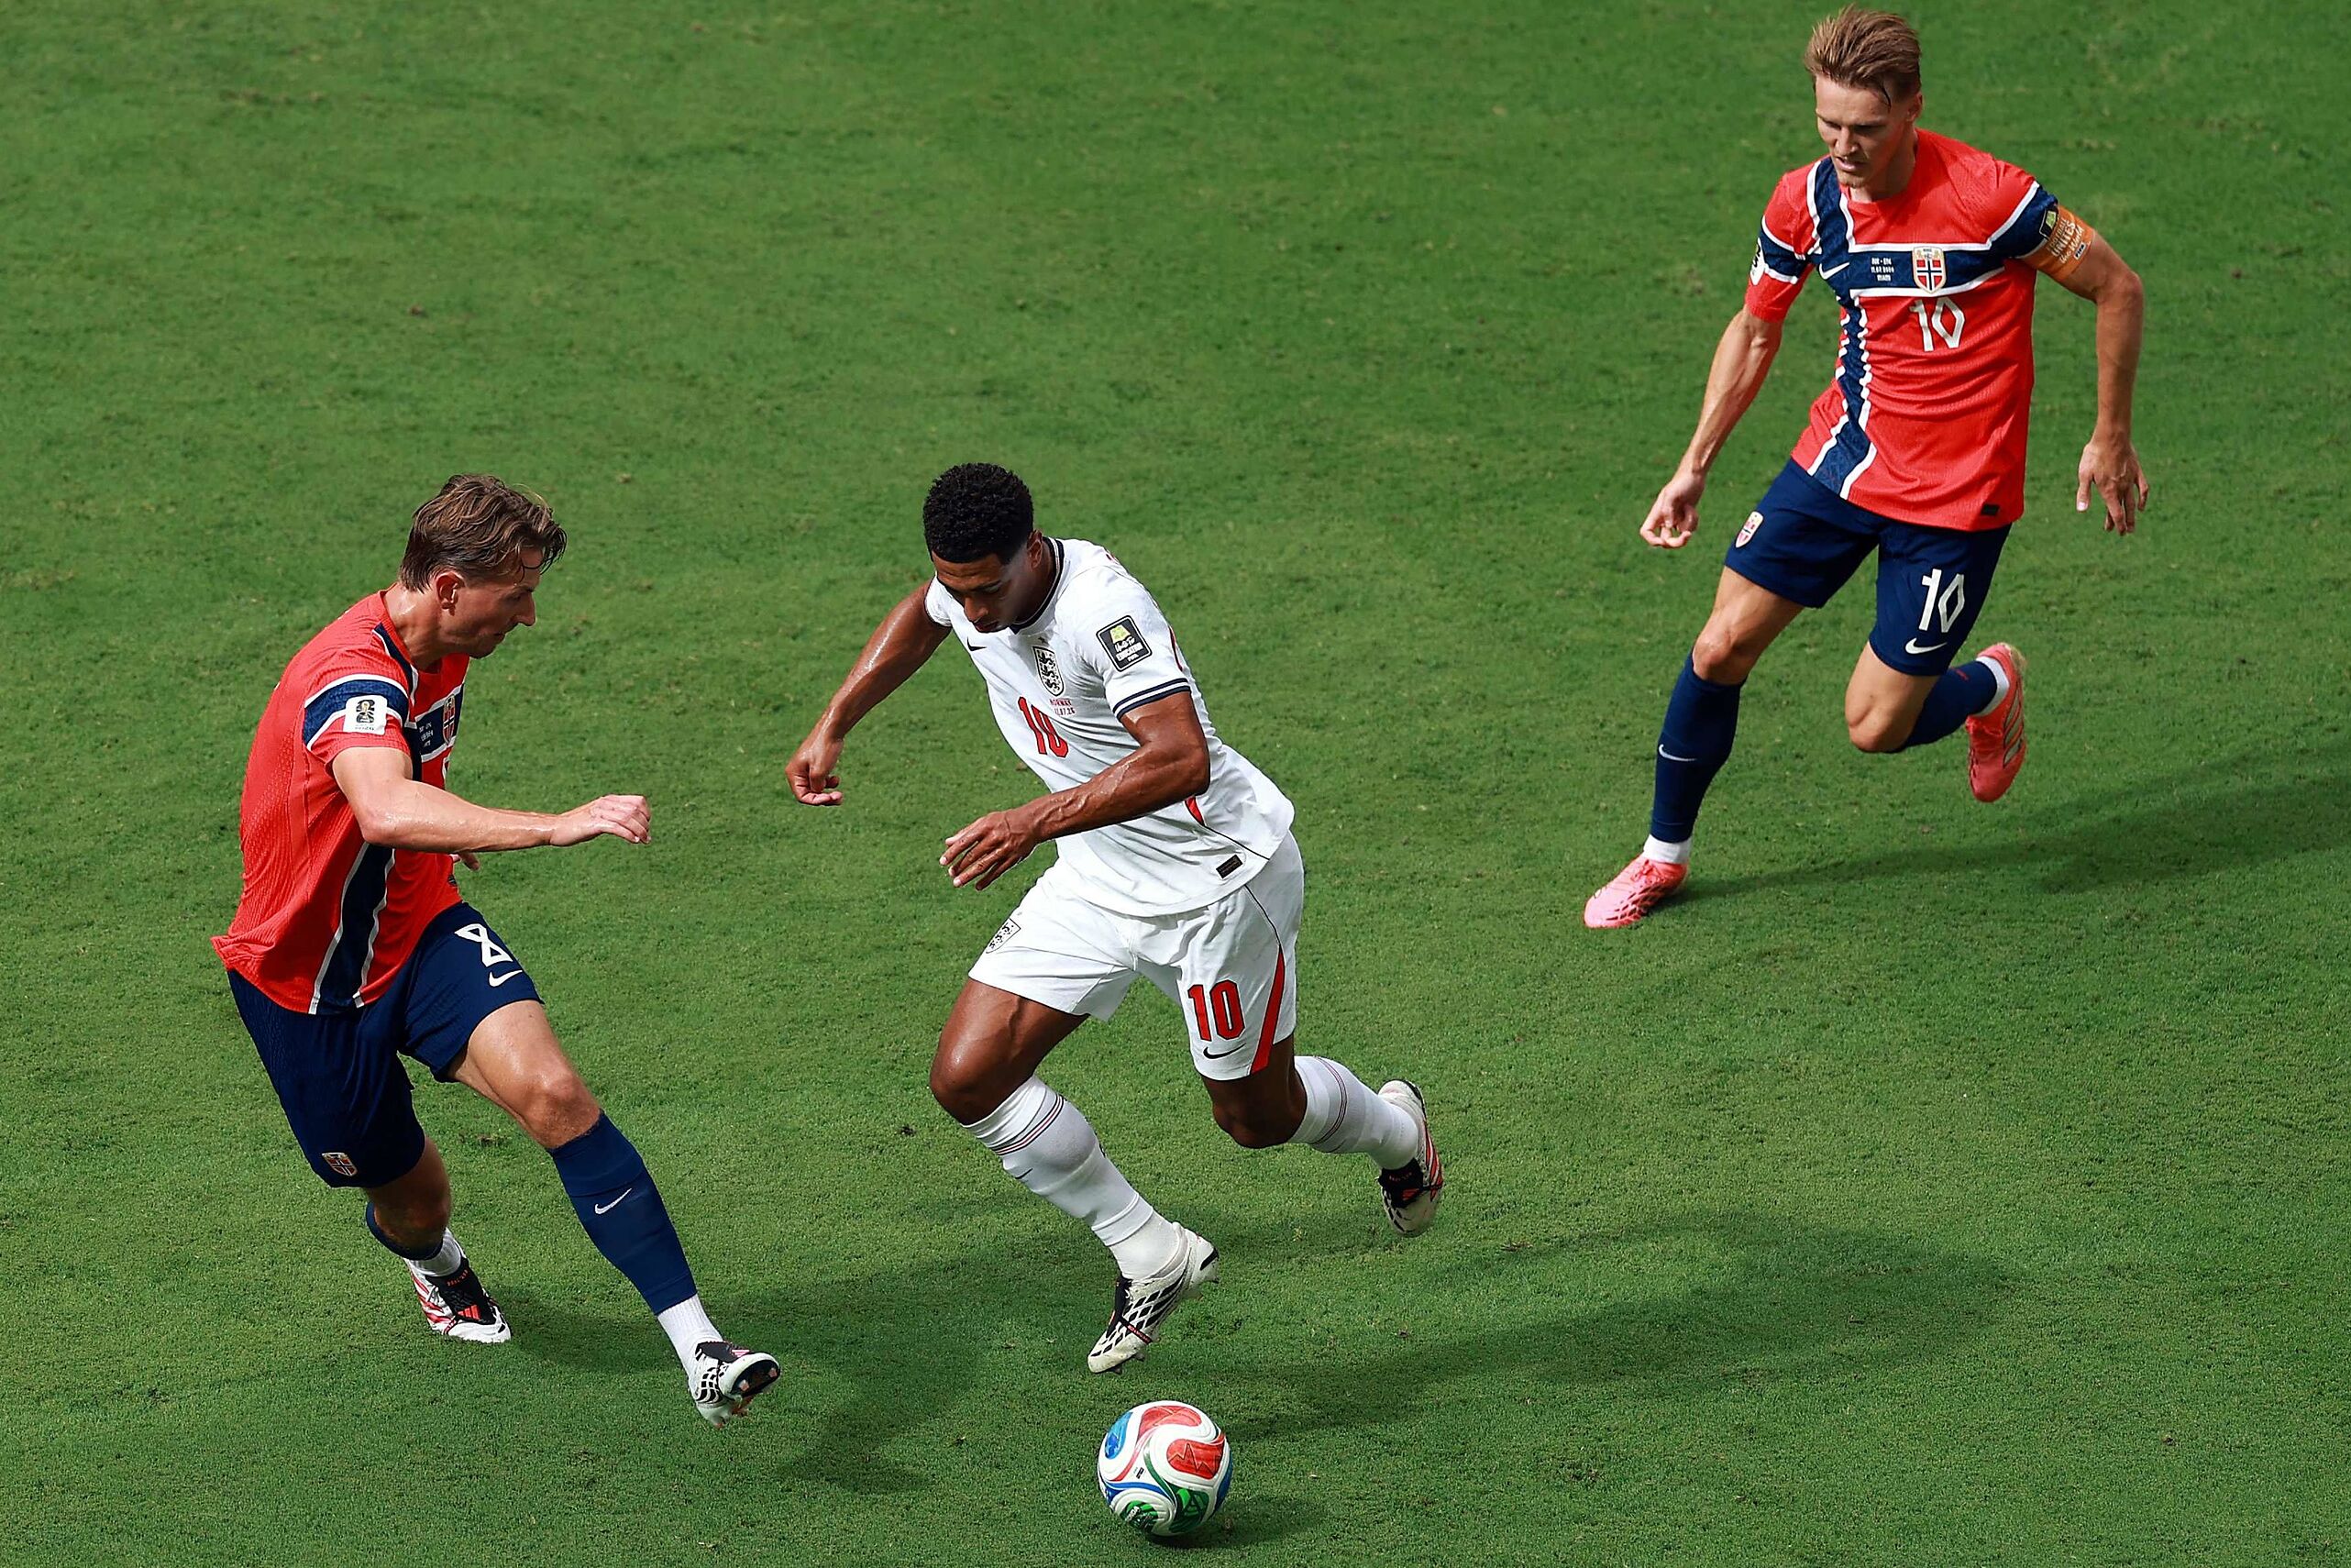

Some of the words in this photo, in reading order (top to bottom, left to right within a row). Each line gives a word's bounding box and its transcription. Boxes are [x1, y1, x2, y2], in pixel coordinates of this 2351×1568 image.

[2051, 220, 2076, 257] UNITES
[1909, 296, 1965, 352] 10
[1918, 568, 1966, 633] 10
[1018, 696, 1068, 757] 10
[454, 923, 513, 967] 8
[1187, 979, 1245, 1042] 10
